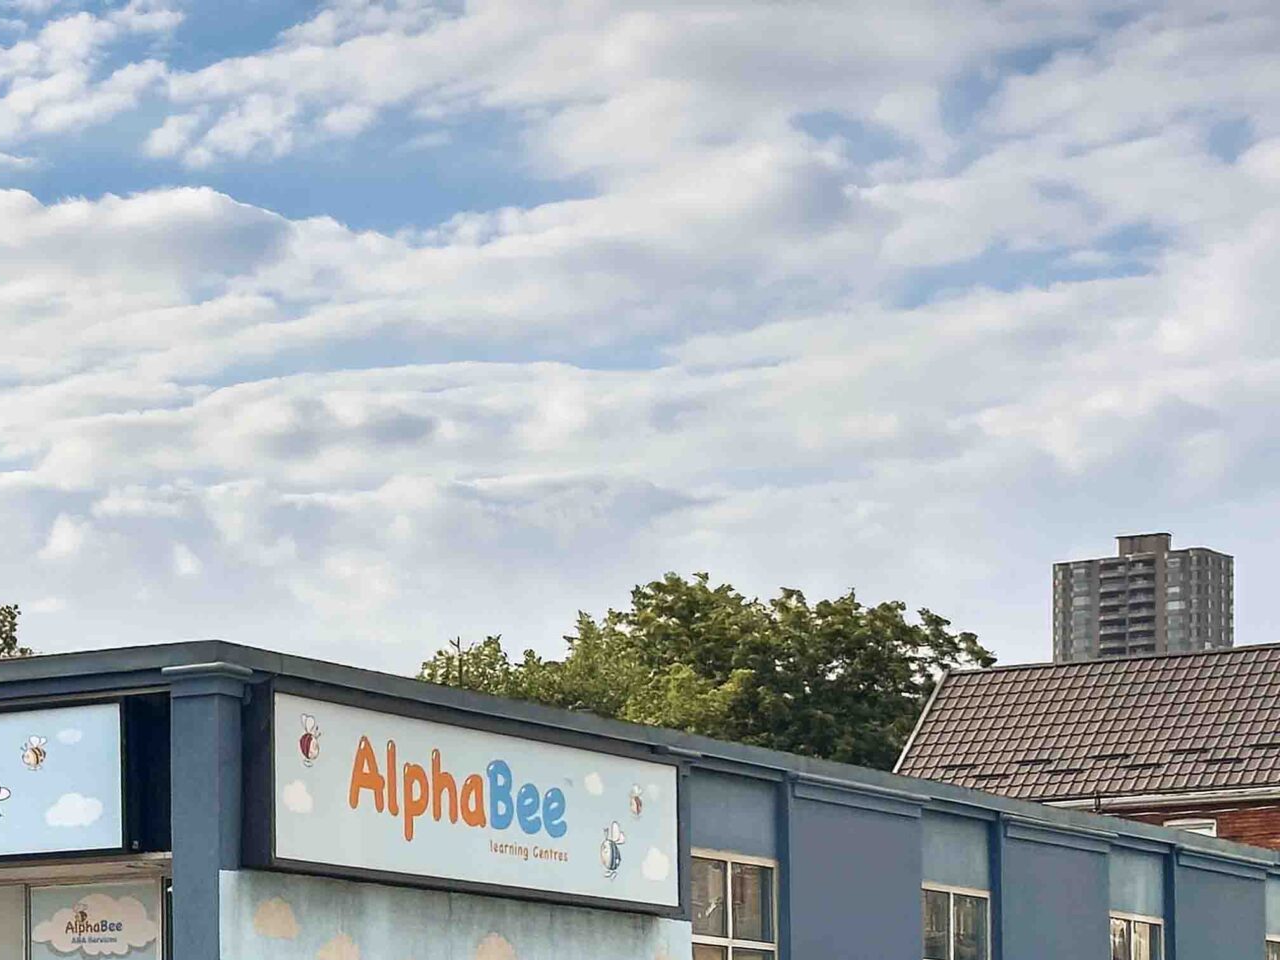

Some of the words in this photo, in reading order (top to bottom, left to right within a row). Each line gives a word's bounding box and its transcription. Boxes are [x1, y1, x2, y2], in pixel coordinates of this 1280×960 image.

[348, 735, 568, 841] AlphaBee
[489, 839, 529, 861] learning
[532, 844, 570, 863] Centres
[65, 919, 123, 936] AlphaBee
